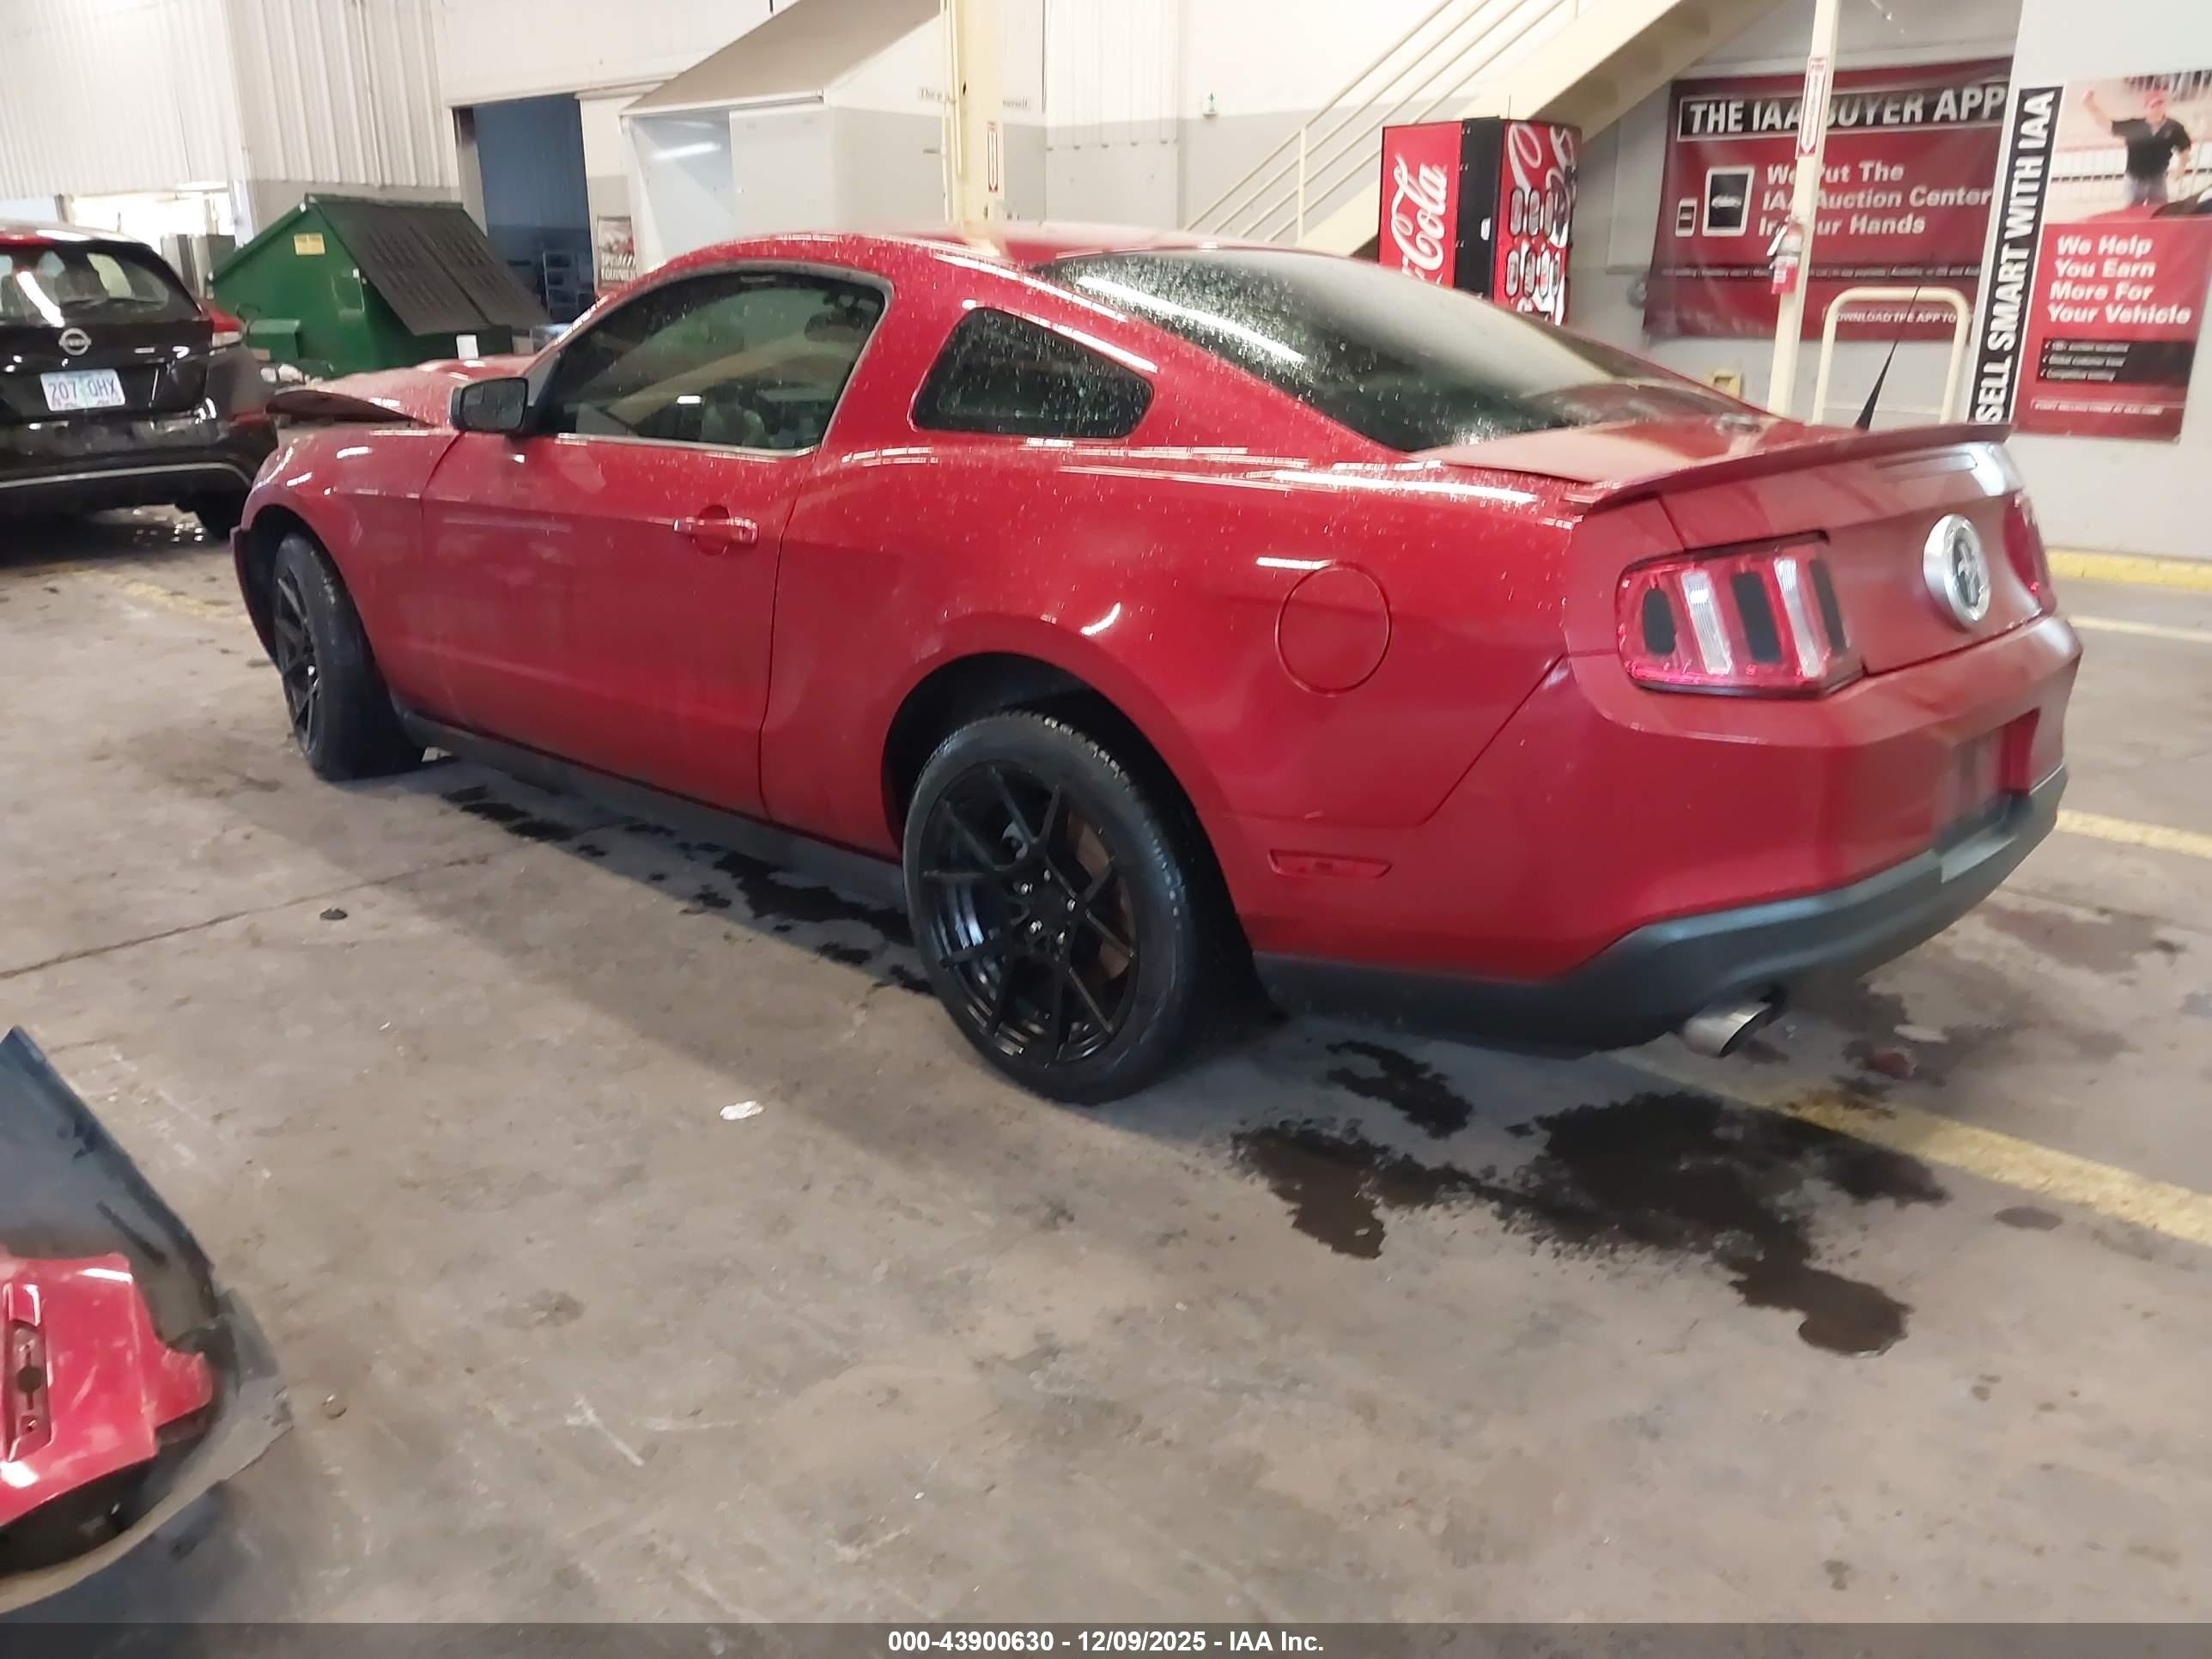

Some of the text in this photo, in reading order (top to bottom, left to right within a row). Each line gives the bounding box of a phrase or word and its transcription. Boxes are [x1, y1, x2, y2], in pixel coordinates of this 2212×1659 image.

[1689, 101, 1744, 133] THE
[1752, 98, 1800, 131] IAA
[1932, 85, 2006, 122] APP
[1858, 160, 1905, 182] The
[1818, 187, 1901, 210] Auction
[1909, 184, 1992, 207] Center
[1390, 153, 1448, 271] Cola
[1816, 219, 1843, 235] ur
[1849, 214, 1926, 235] Hands
[1975, 90, 2055, 422] SELL SMART WITH IAA
[2057, 234, 2154, 258] We Help
[2055, 258, 2157, 278] You Earn
[2050, 280, 2155, 301] More For
[1837, 311, 1893, 323] OWNLOAD
[2047, 302, 2192, 325] Your Vehicle
